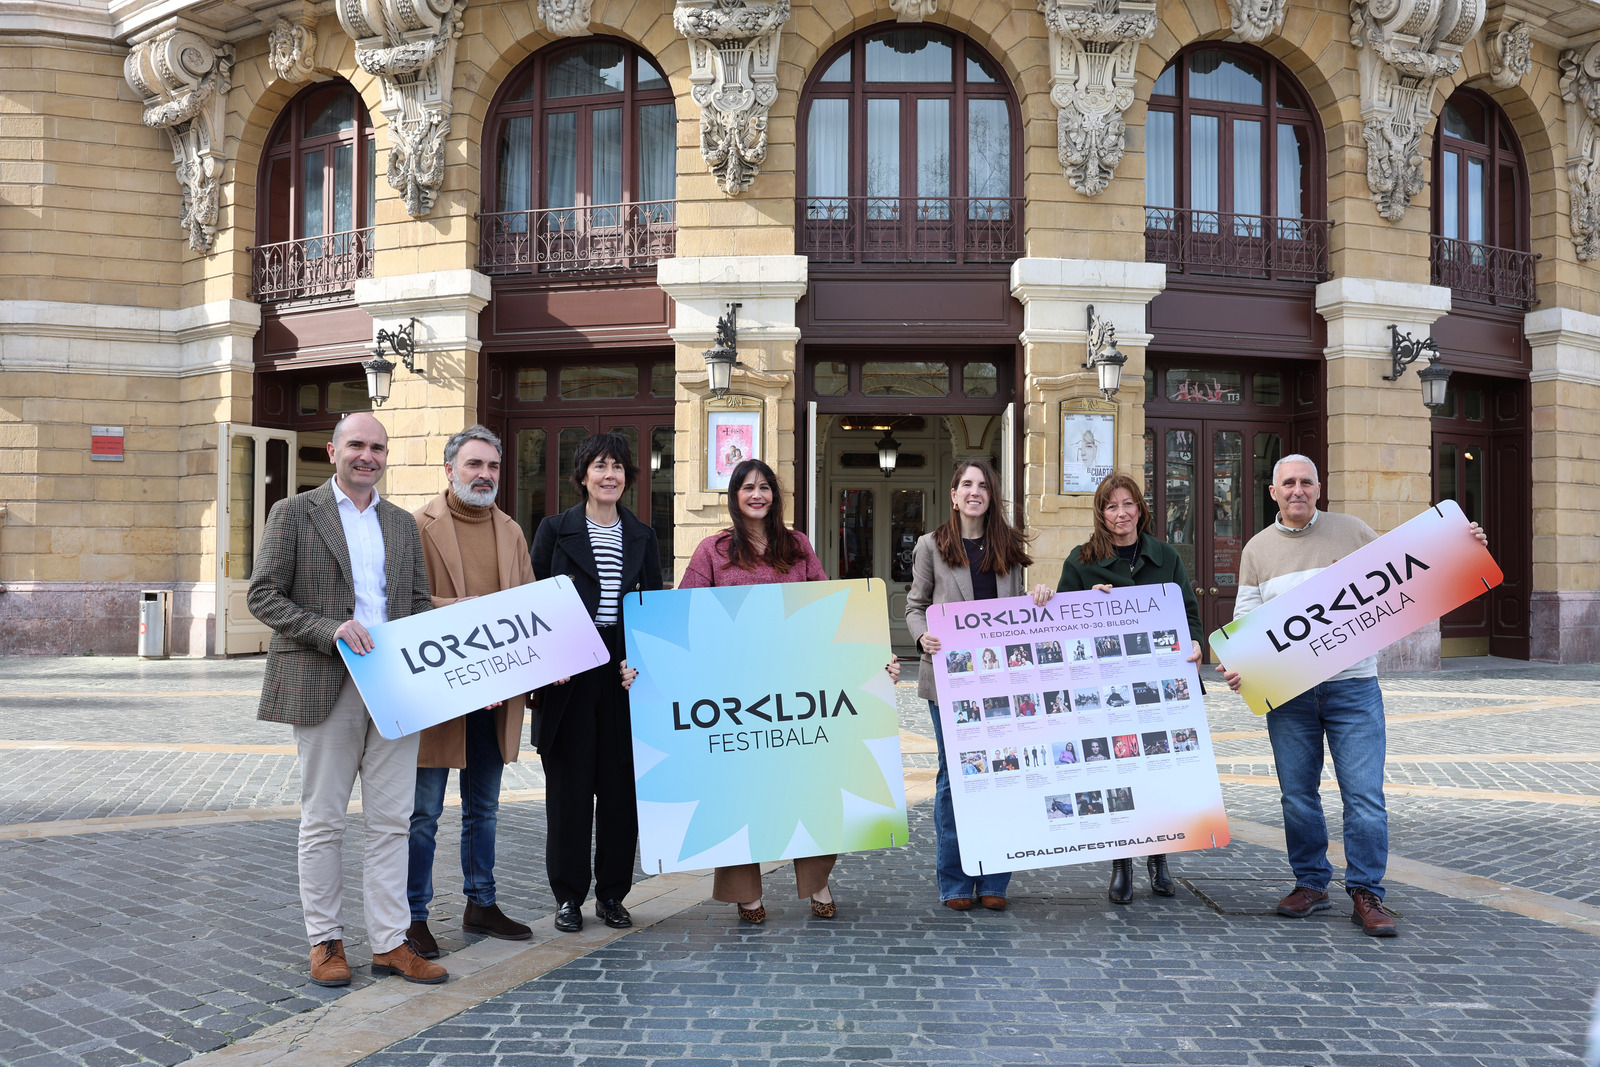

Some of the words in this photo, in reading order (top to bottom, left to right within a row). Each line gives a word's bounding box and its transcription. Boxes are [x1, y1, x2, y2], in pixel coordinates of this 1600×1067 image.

[1059, 597, 1161, 621] FESTIBALA
[990, 629, 1028, 638] EDIZIOA.
[1029, 624, 1079, 635] MARTXOAK
[1080, 621, 1106, 630] 10-30.
[1106, 618, 1139, 627] BILBON
[1309, 591, 1416, 657] FESTIBALA
[443, 645, 541, 690] FESTIBALA
[708, 725, 829, 753] FESTIBALA
[1006, 832, 1186, 860] LORALDIAFESTIBALA.EUS
